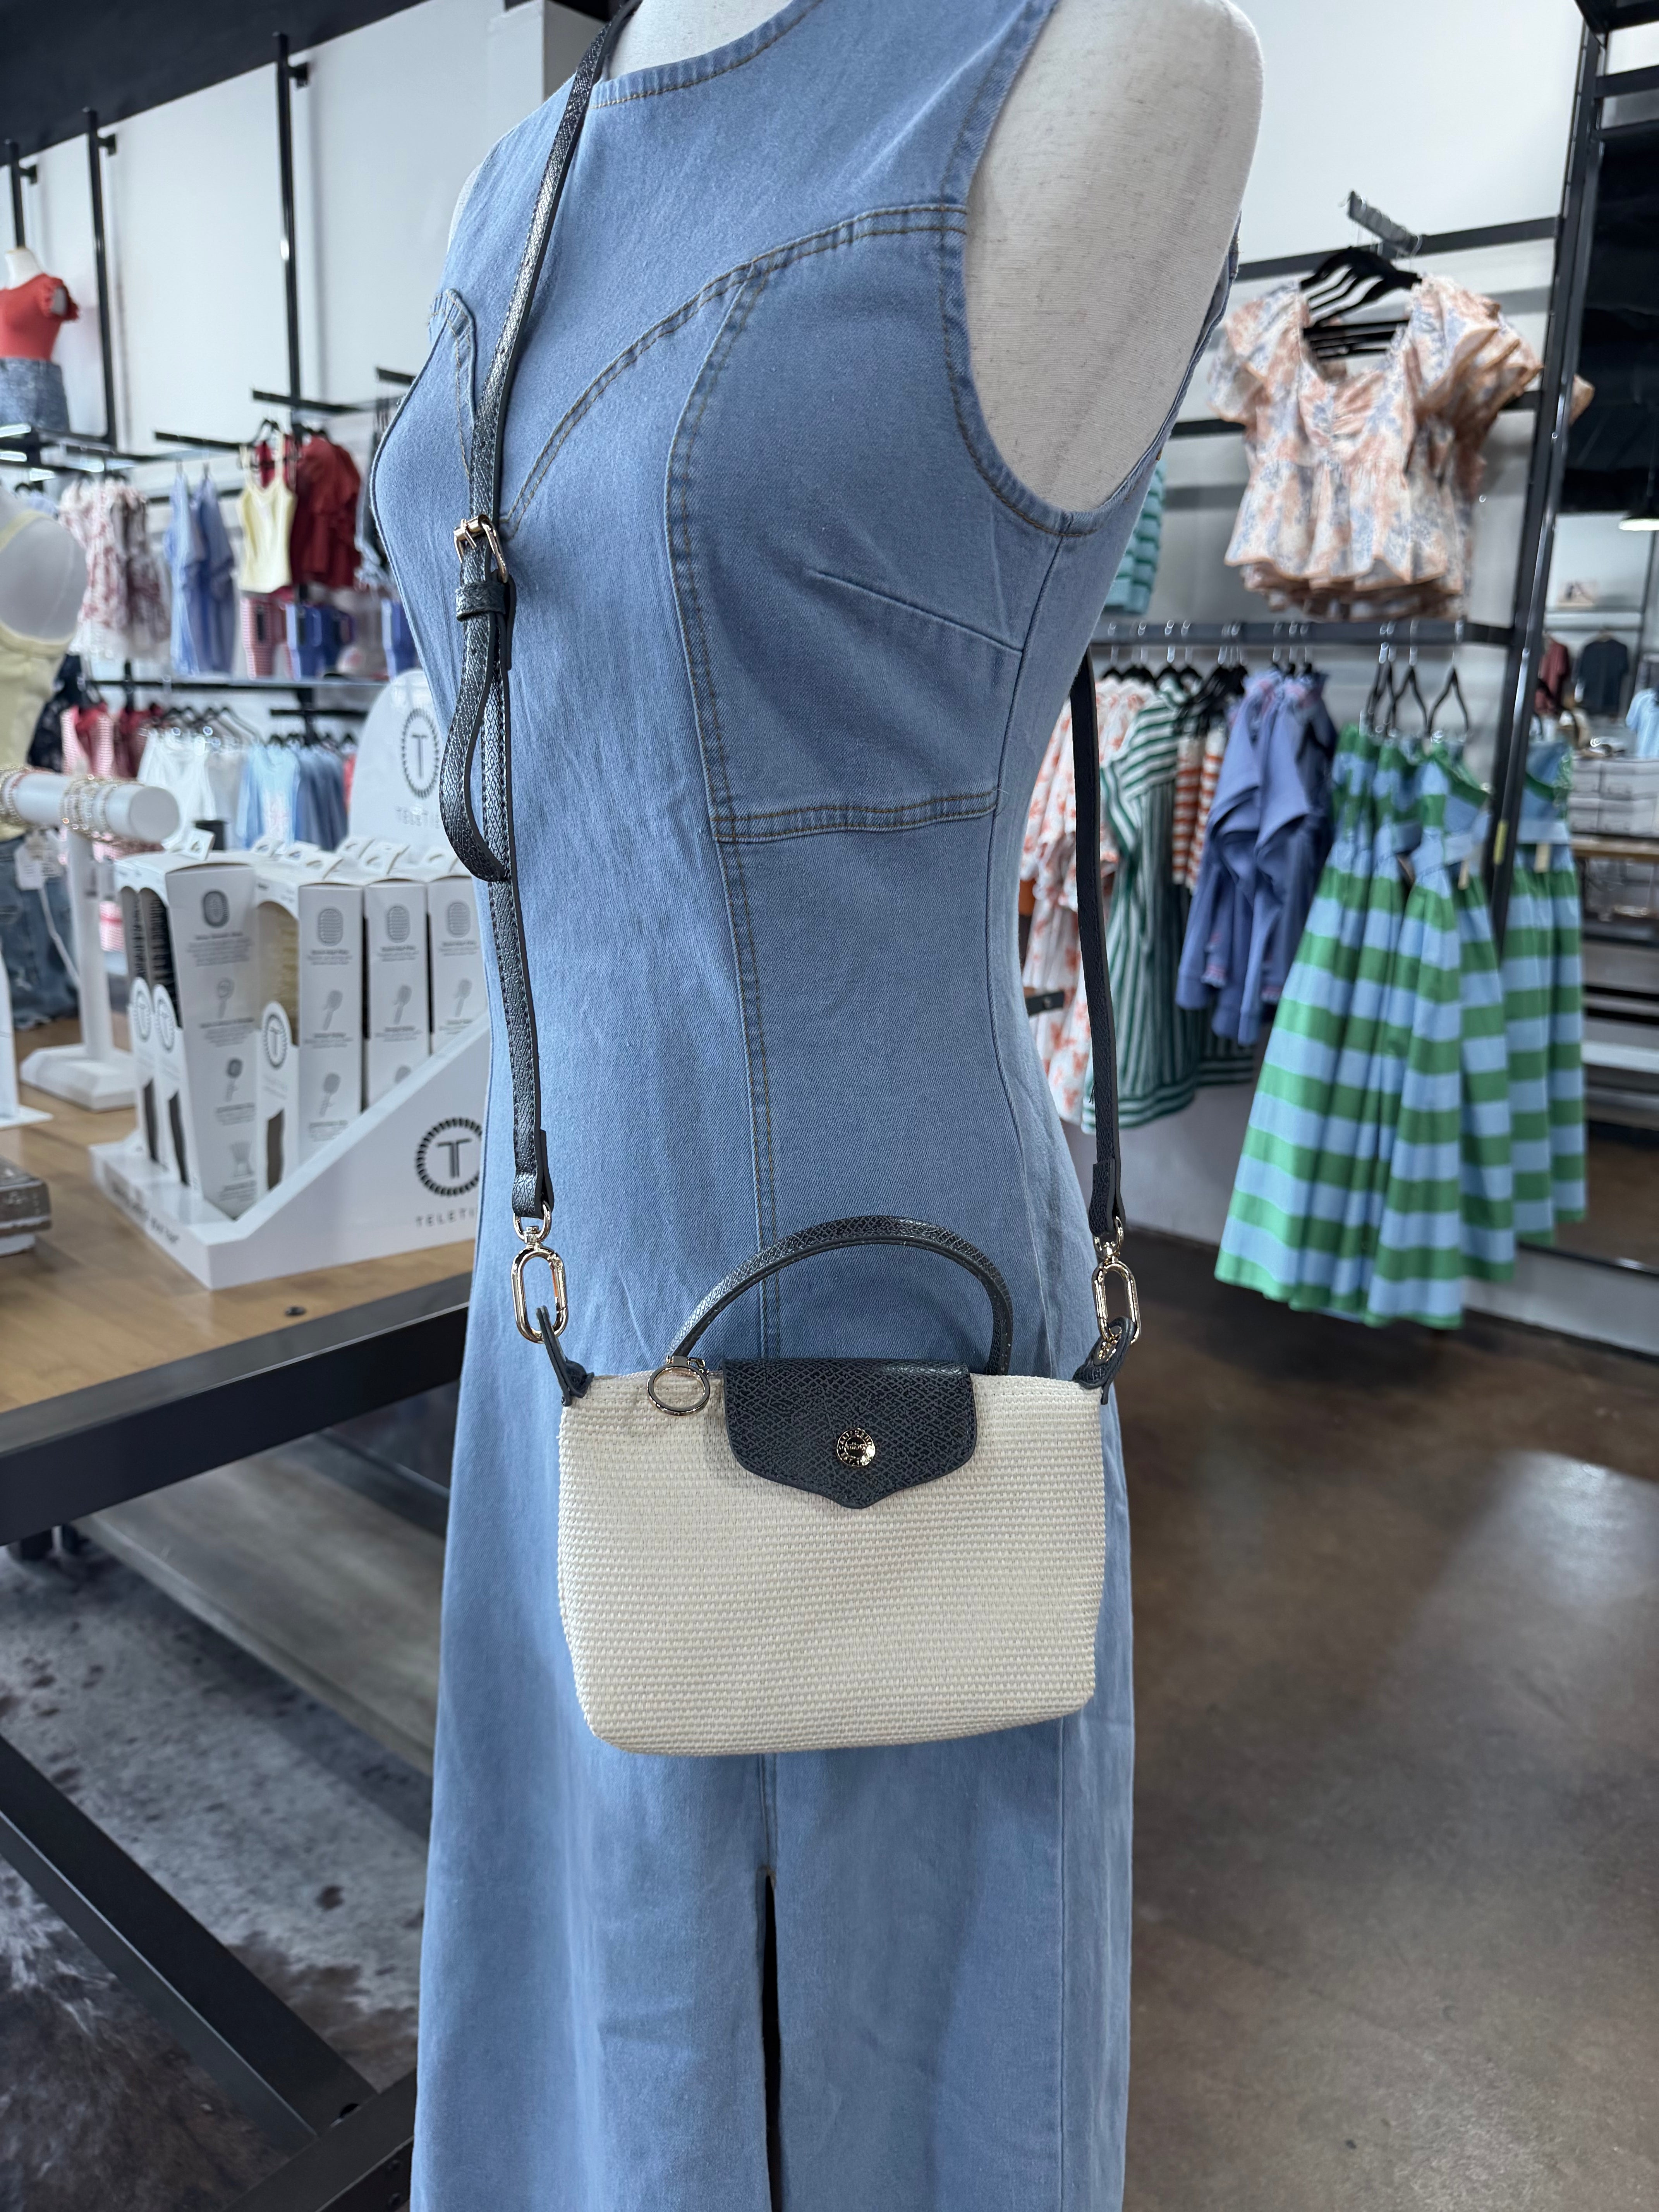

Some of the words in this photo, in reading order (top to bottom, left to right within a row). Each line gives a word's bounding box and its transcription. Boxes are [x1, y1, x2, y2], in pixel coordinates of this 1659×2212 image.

[410, 733, 429, 779] T
[436, 1138, 472, 1178] T
[415, 1207, 478, 1226] TELETI
